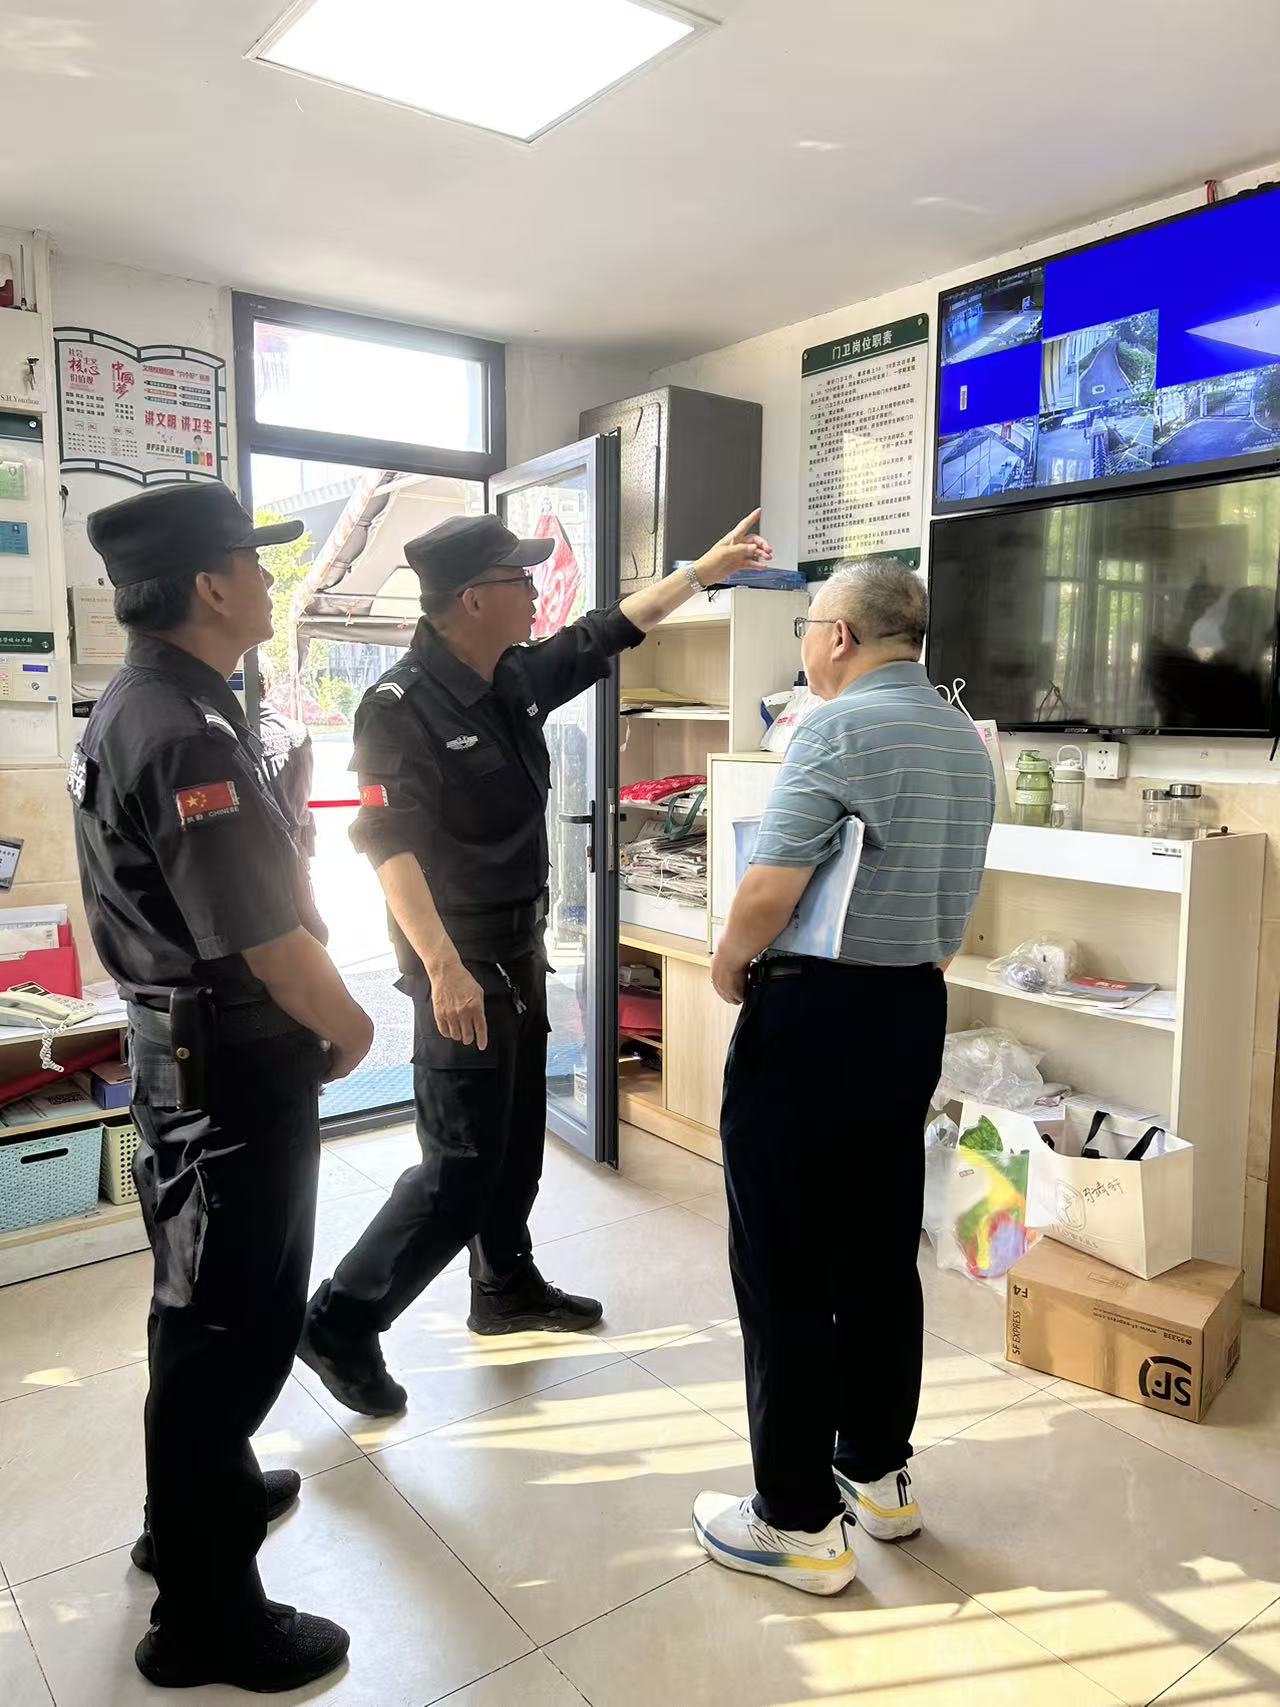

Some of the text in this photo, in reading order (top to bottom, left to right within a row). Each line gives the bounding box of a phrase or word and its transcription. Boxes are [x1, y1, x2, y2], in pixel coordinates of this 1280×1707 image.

[832, 330, 892, 360] 门卫岗位职责
[144, 410, 177, 430] 讲文明
[181, 416, 212, 435] 讲卫生
[1013, 1284, 1028, 1298] F4
[1012, 1310, 1021, 1355] SF EXPRESS
